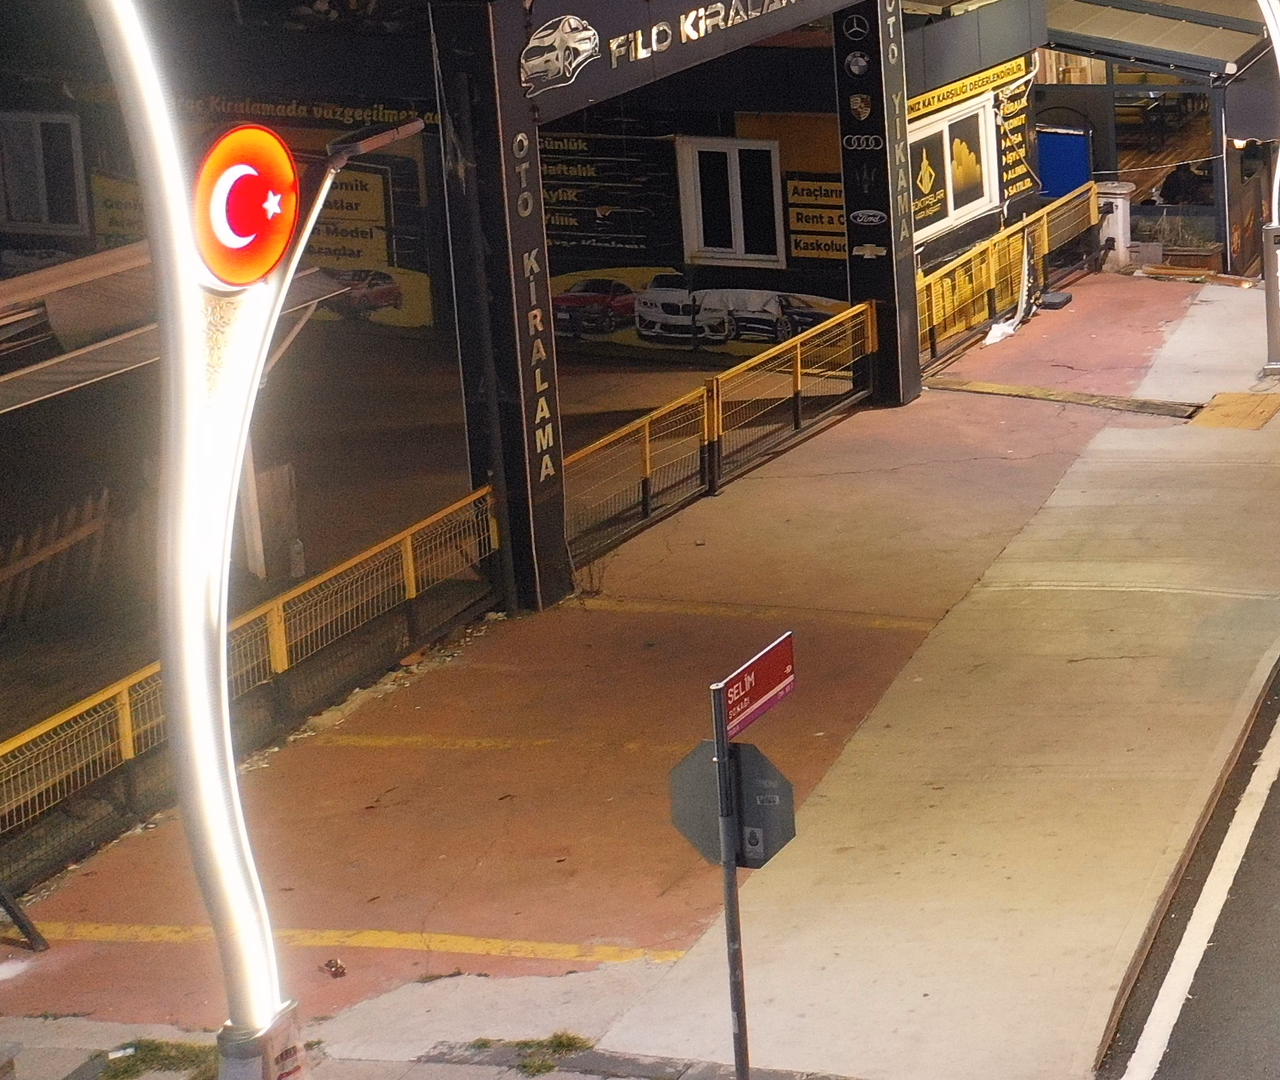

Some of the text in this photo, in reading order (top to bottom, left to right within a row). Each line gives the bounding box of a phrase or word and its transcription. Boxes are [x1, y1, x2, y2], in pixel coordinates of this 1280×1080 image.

[609, 20, 673, 70] FİLO
[922, 96, 936, 111] KAT
[512, 132, 534, 218] OTO
[891, 91, 912, 241] YIKAMA
[796, 212, 824, 224] Rent
[522, 247, 554, 482] KİRALAMA
[727, 671, 756, 705] SELİM
[728, 696, 751, 720] SOKAĞI
